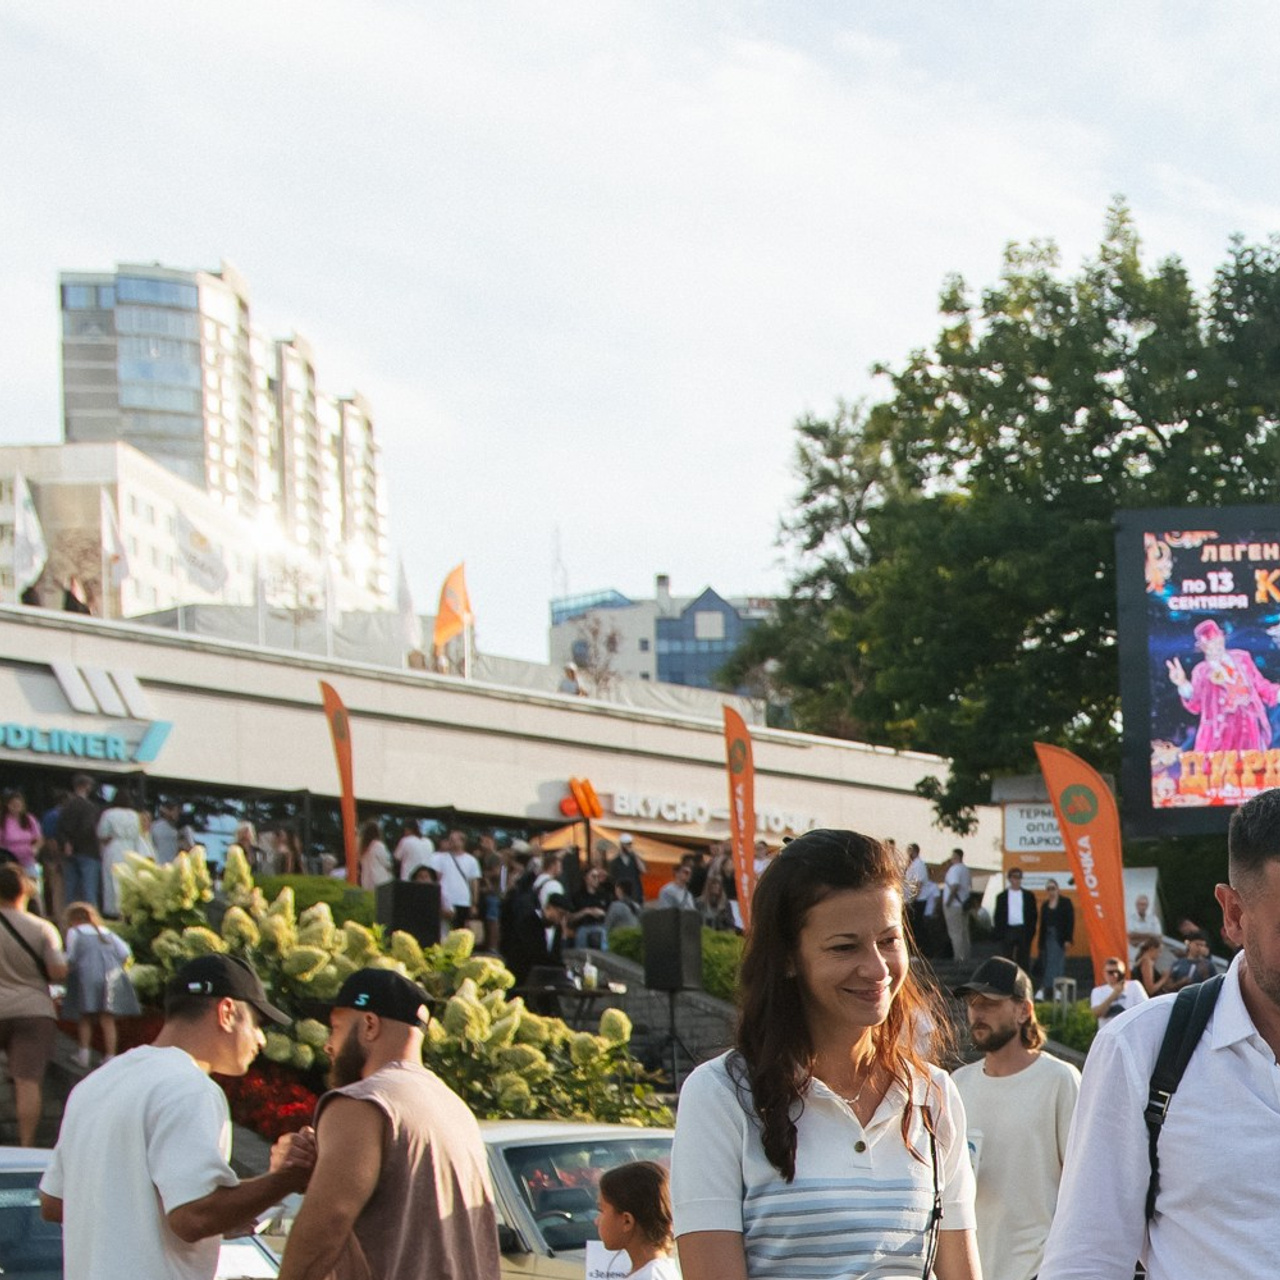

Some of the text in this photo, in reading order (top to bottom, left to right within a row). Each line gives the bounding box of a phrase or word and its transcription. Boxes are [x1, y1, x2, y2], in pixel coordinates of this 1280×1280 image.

[1206, 571, 1235, 593] 13
[1168, 594, 1249, 611] СЕНТЯБРЯ
[0, 722, 128, 762] DLINER
[613, 791, 711, 824] ВКУСНО
[1019, 836, 1063, 847] ПАРКО
